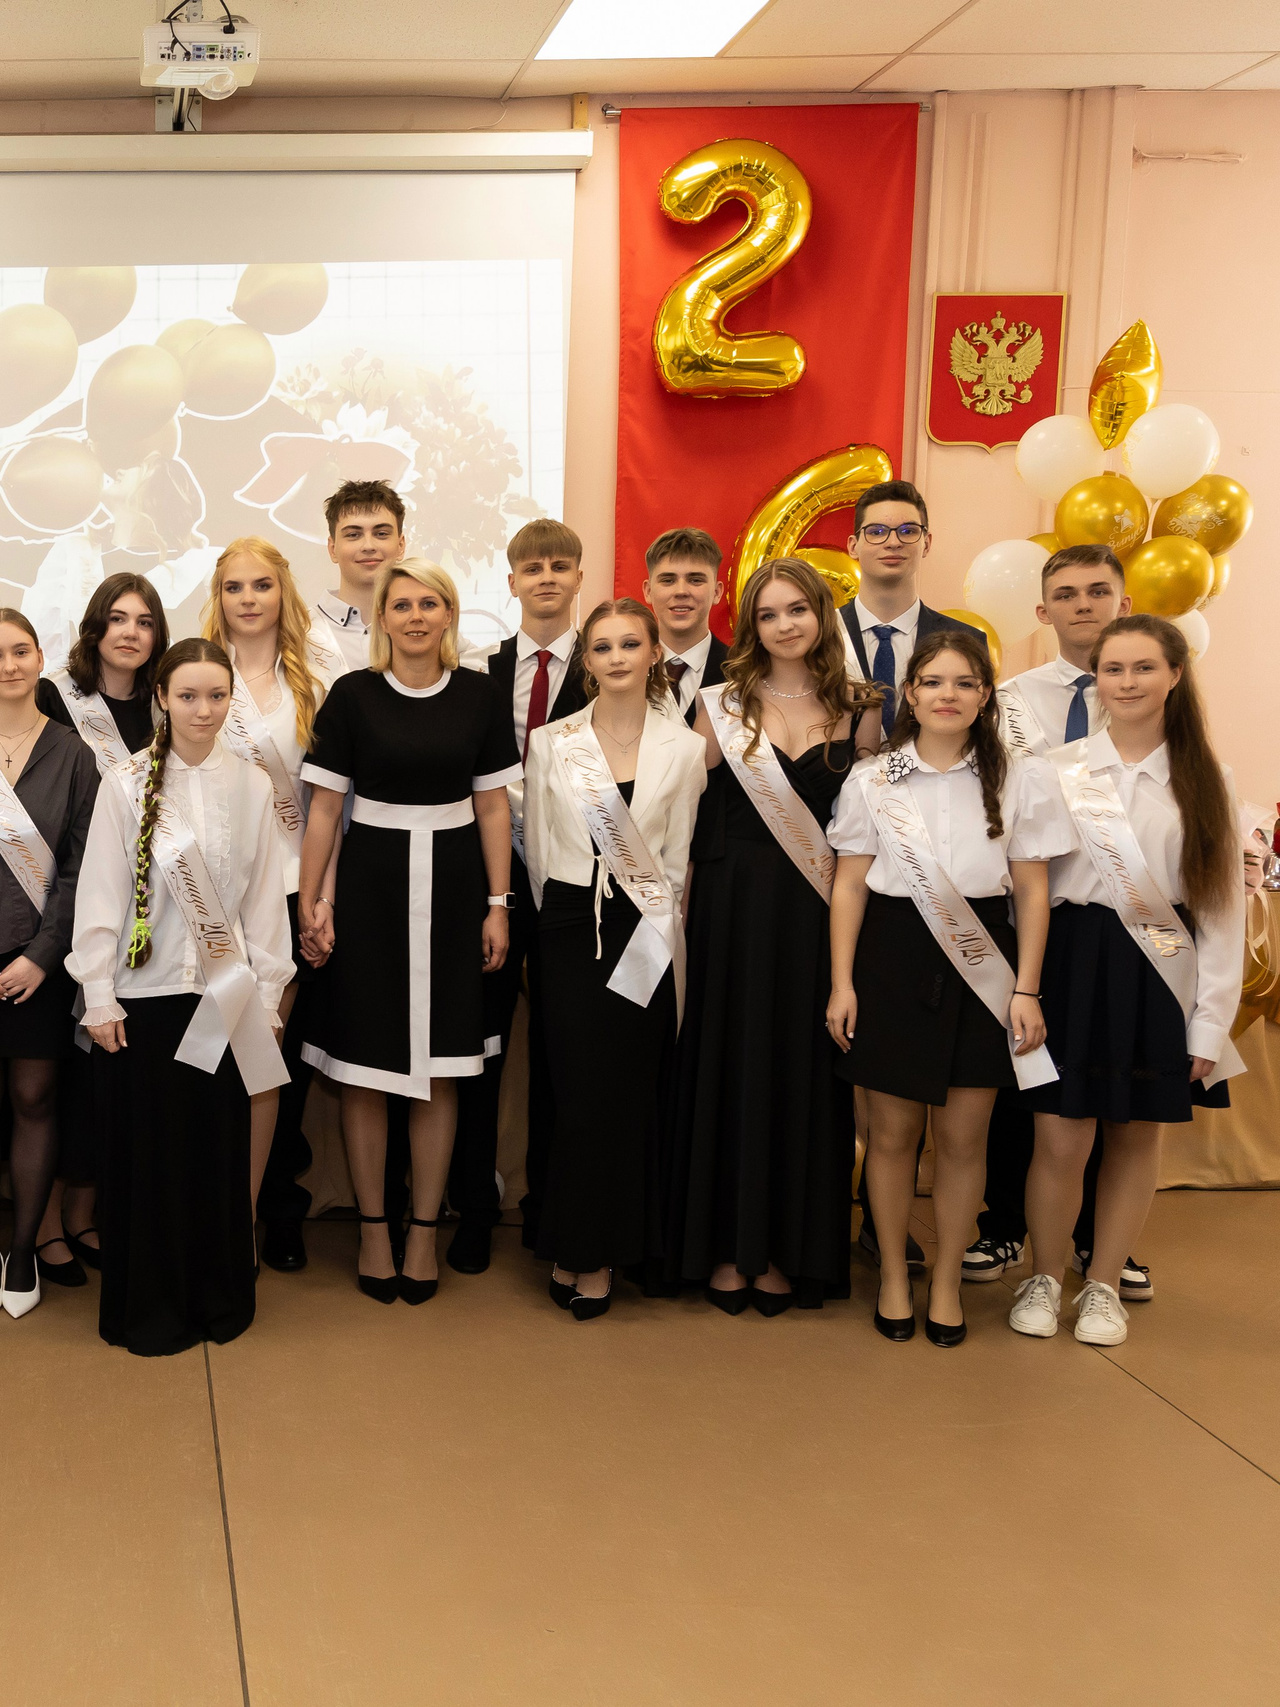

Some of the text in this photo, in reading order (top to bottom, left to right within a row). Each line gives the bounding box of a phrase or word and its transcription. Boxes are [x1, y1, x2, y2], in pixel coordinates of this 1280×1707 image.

[652, 137, 812, 398] 2
[274, 797, 305, 831] 2026
[565, 747, 670, 907] Выпускница 2026
[877, 798, 993, 966] Выпускница 2026
[197, 921, 235, 959] 2026
[1138, 920, 1190, 958] 2026
